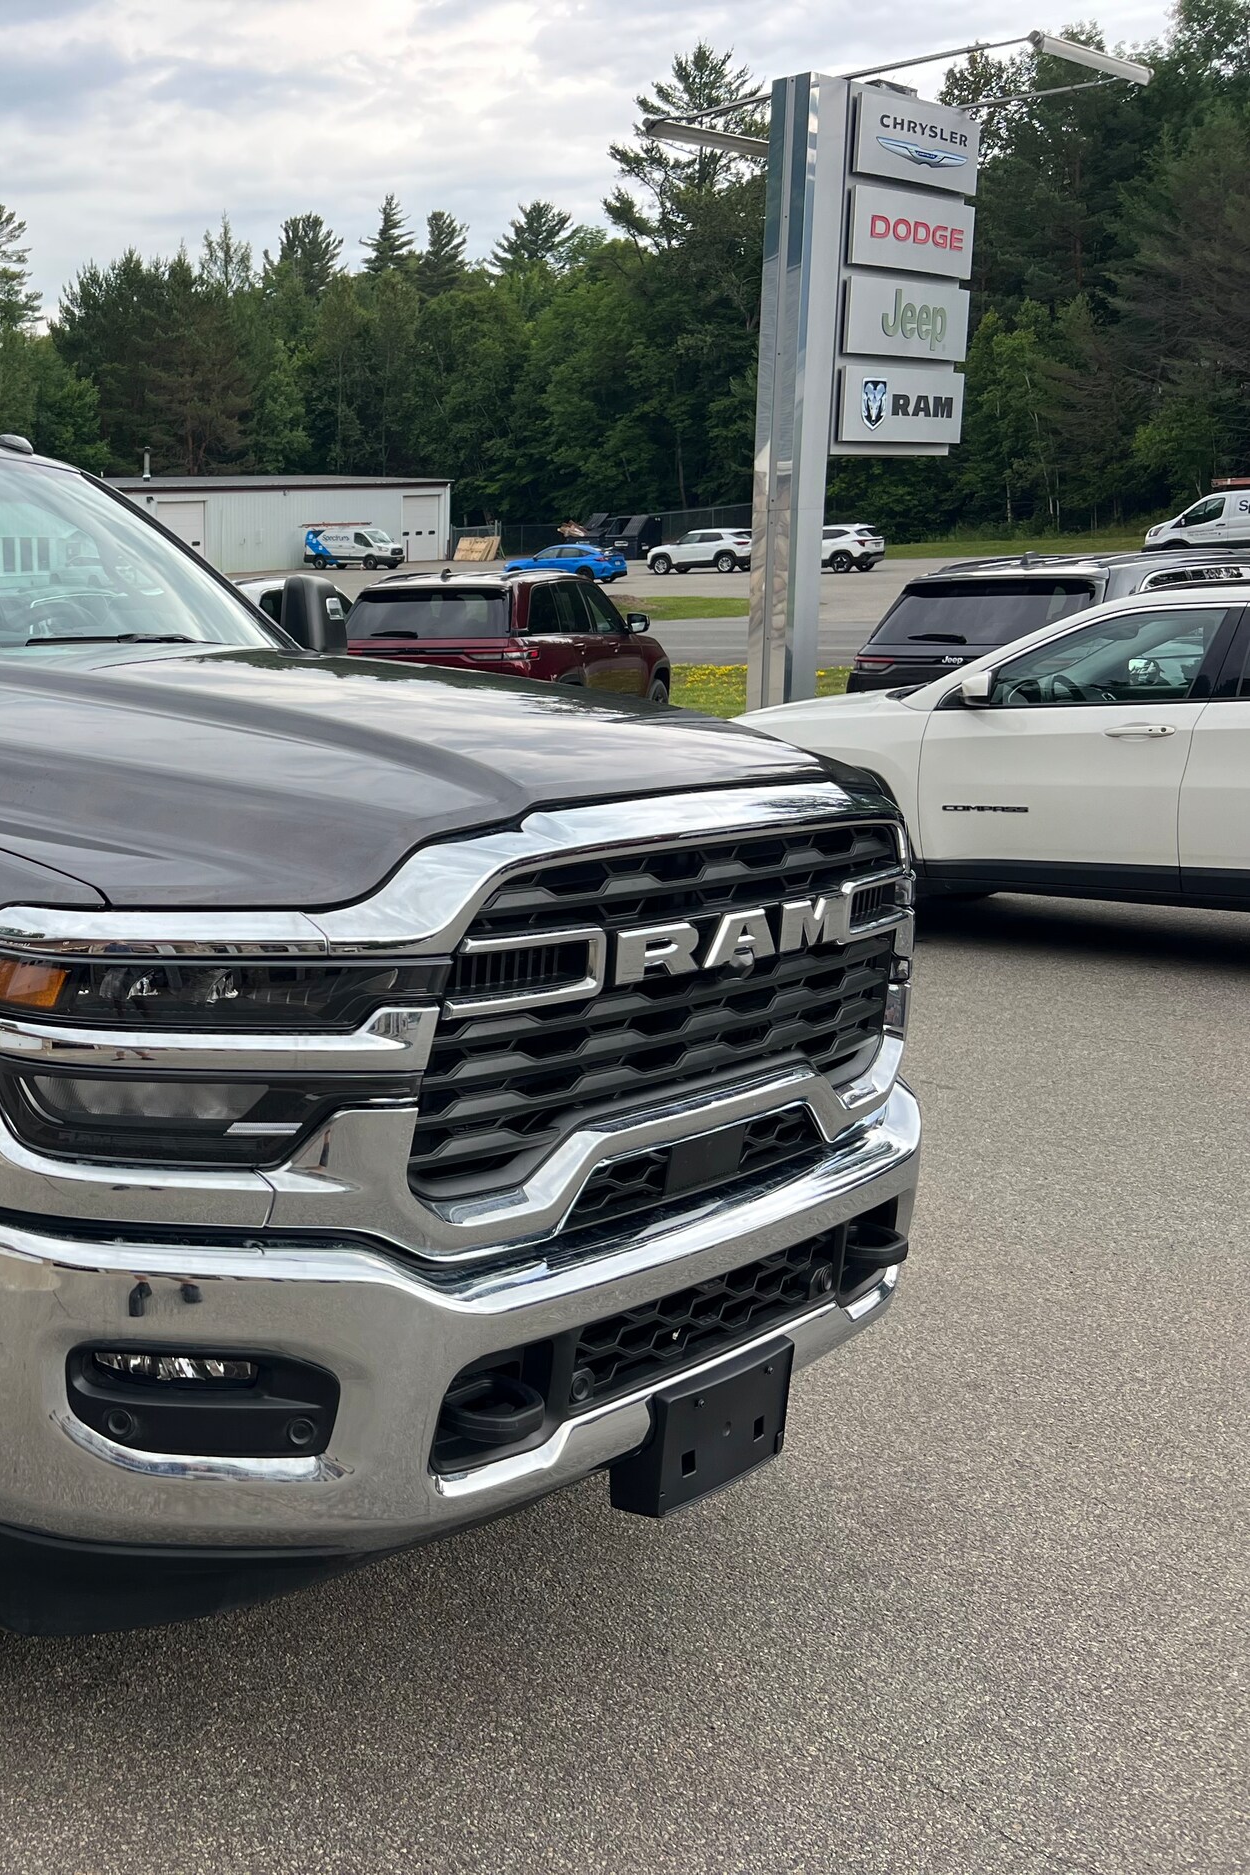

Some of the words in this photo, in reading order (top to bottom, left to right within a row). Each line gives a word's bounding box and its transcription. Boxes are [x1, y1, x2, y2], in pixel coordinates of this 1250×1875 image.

[880, 114, 968, 147] CHRYSLER
[870, 214, 964, 251] DODGE
[881, 289, 947, 351] Jeep
[890, 393, 954, 419] RAM
[1238, 500, 1250, 513] S
[322, 534, 348, 542] Spectrum
[941, 655, 964, 665] Jeep
[942, 805, 1029, 813] COMPASS
[615, 894, 848, 985] RAM
